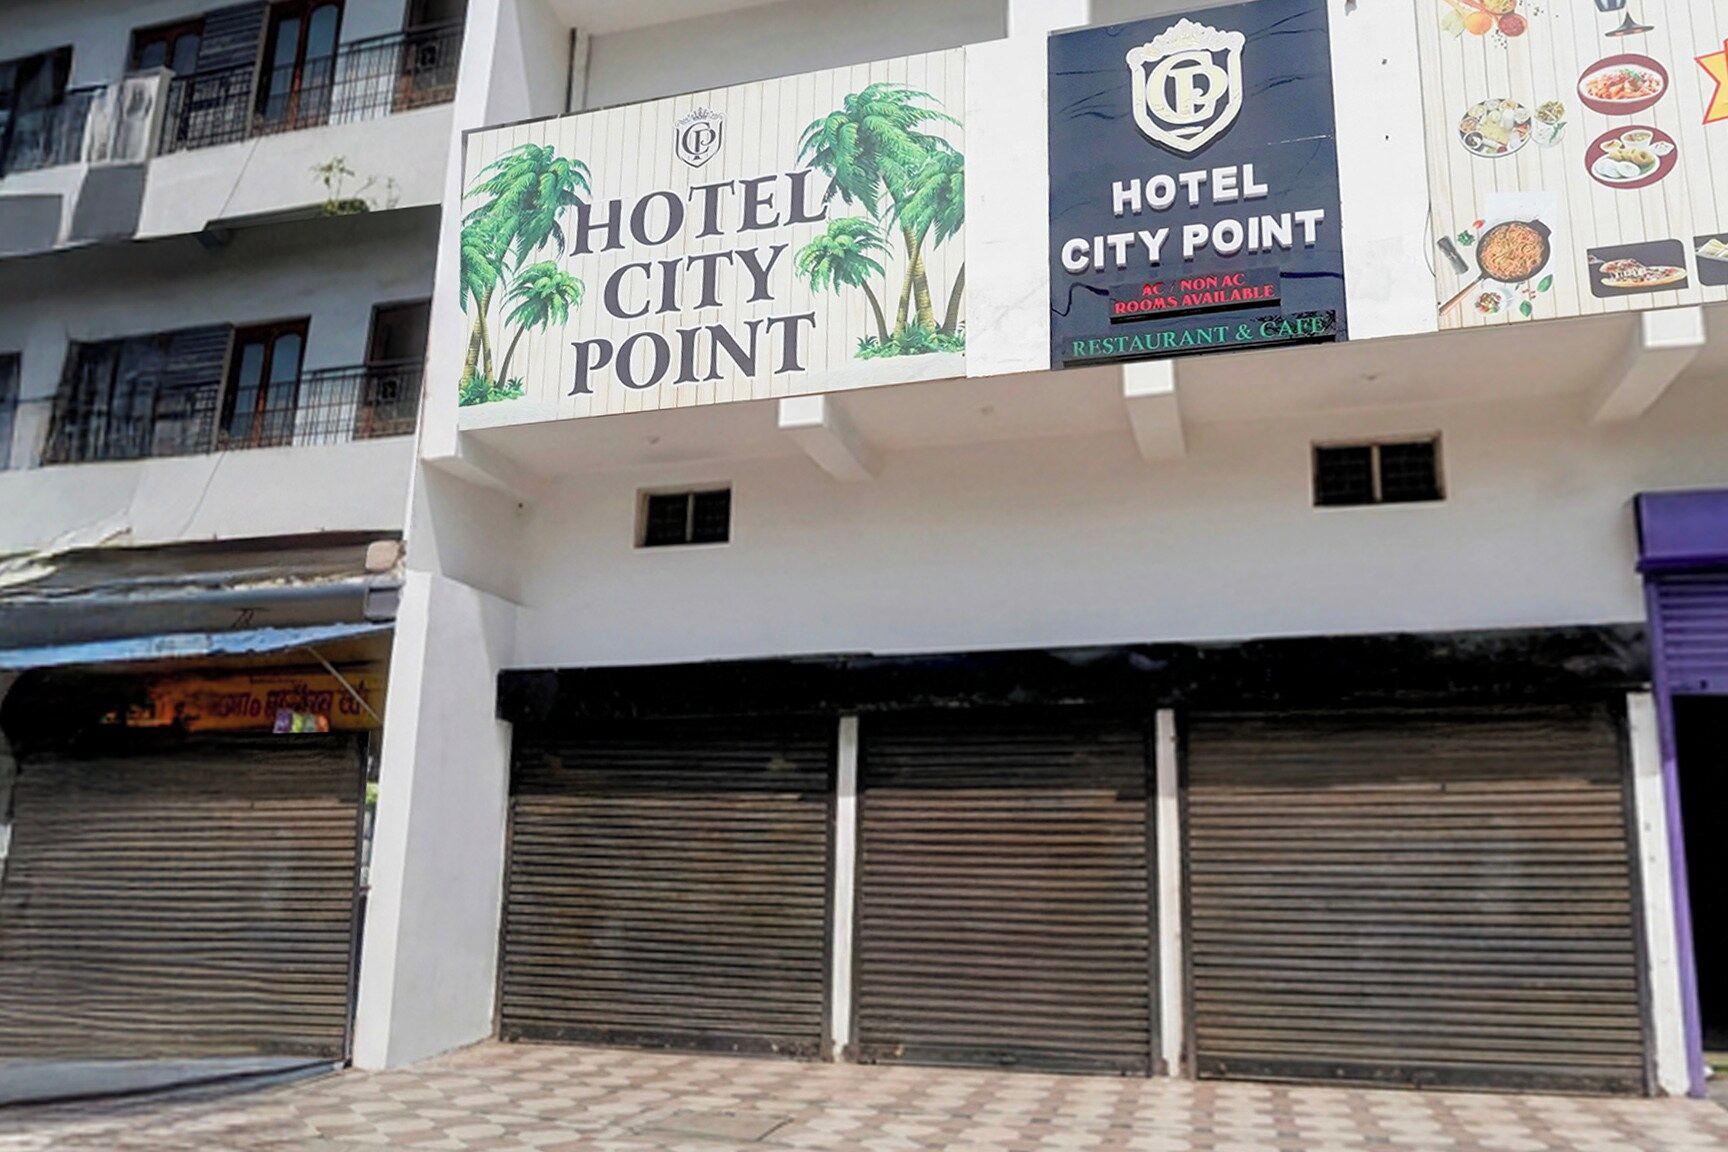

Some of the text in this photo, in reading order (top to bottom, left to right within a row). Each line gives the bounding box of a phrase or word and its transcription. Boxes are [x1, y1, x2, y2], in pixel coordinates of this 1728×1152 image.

[569, 168, 830, 257] HOTEL
[1112, 163, 1268, 216] HOTEL
[1061, 209, 1325, 274] CITY POINT
[603, 243, 789, 320] CITY
[1114, 284, 1275, 315] ROOMS AVAILABLE
[1142, 281, 1164, 296] AC
[1180, 275, 1218, 291] NON
[1221, 273, 1246, 287] AC
[567, 311, 816, 398] POINT
[1071, 325, 1229, 358] RESTAURANT
[1236, 323, 1252, 341] &
